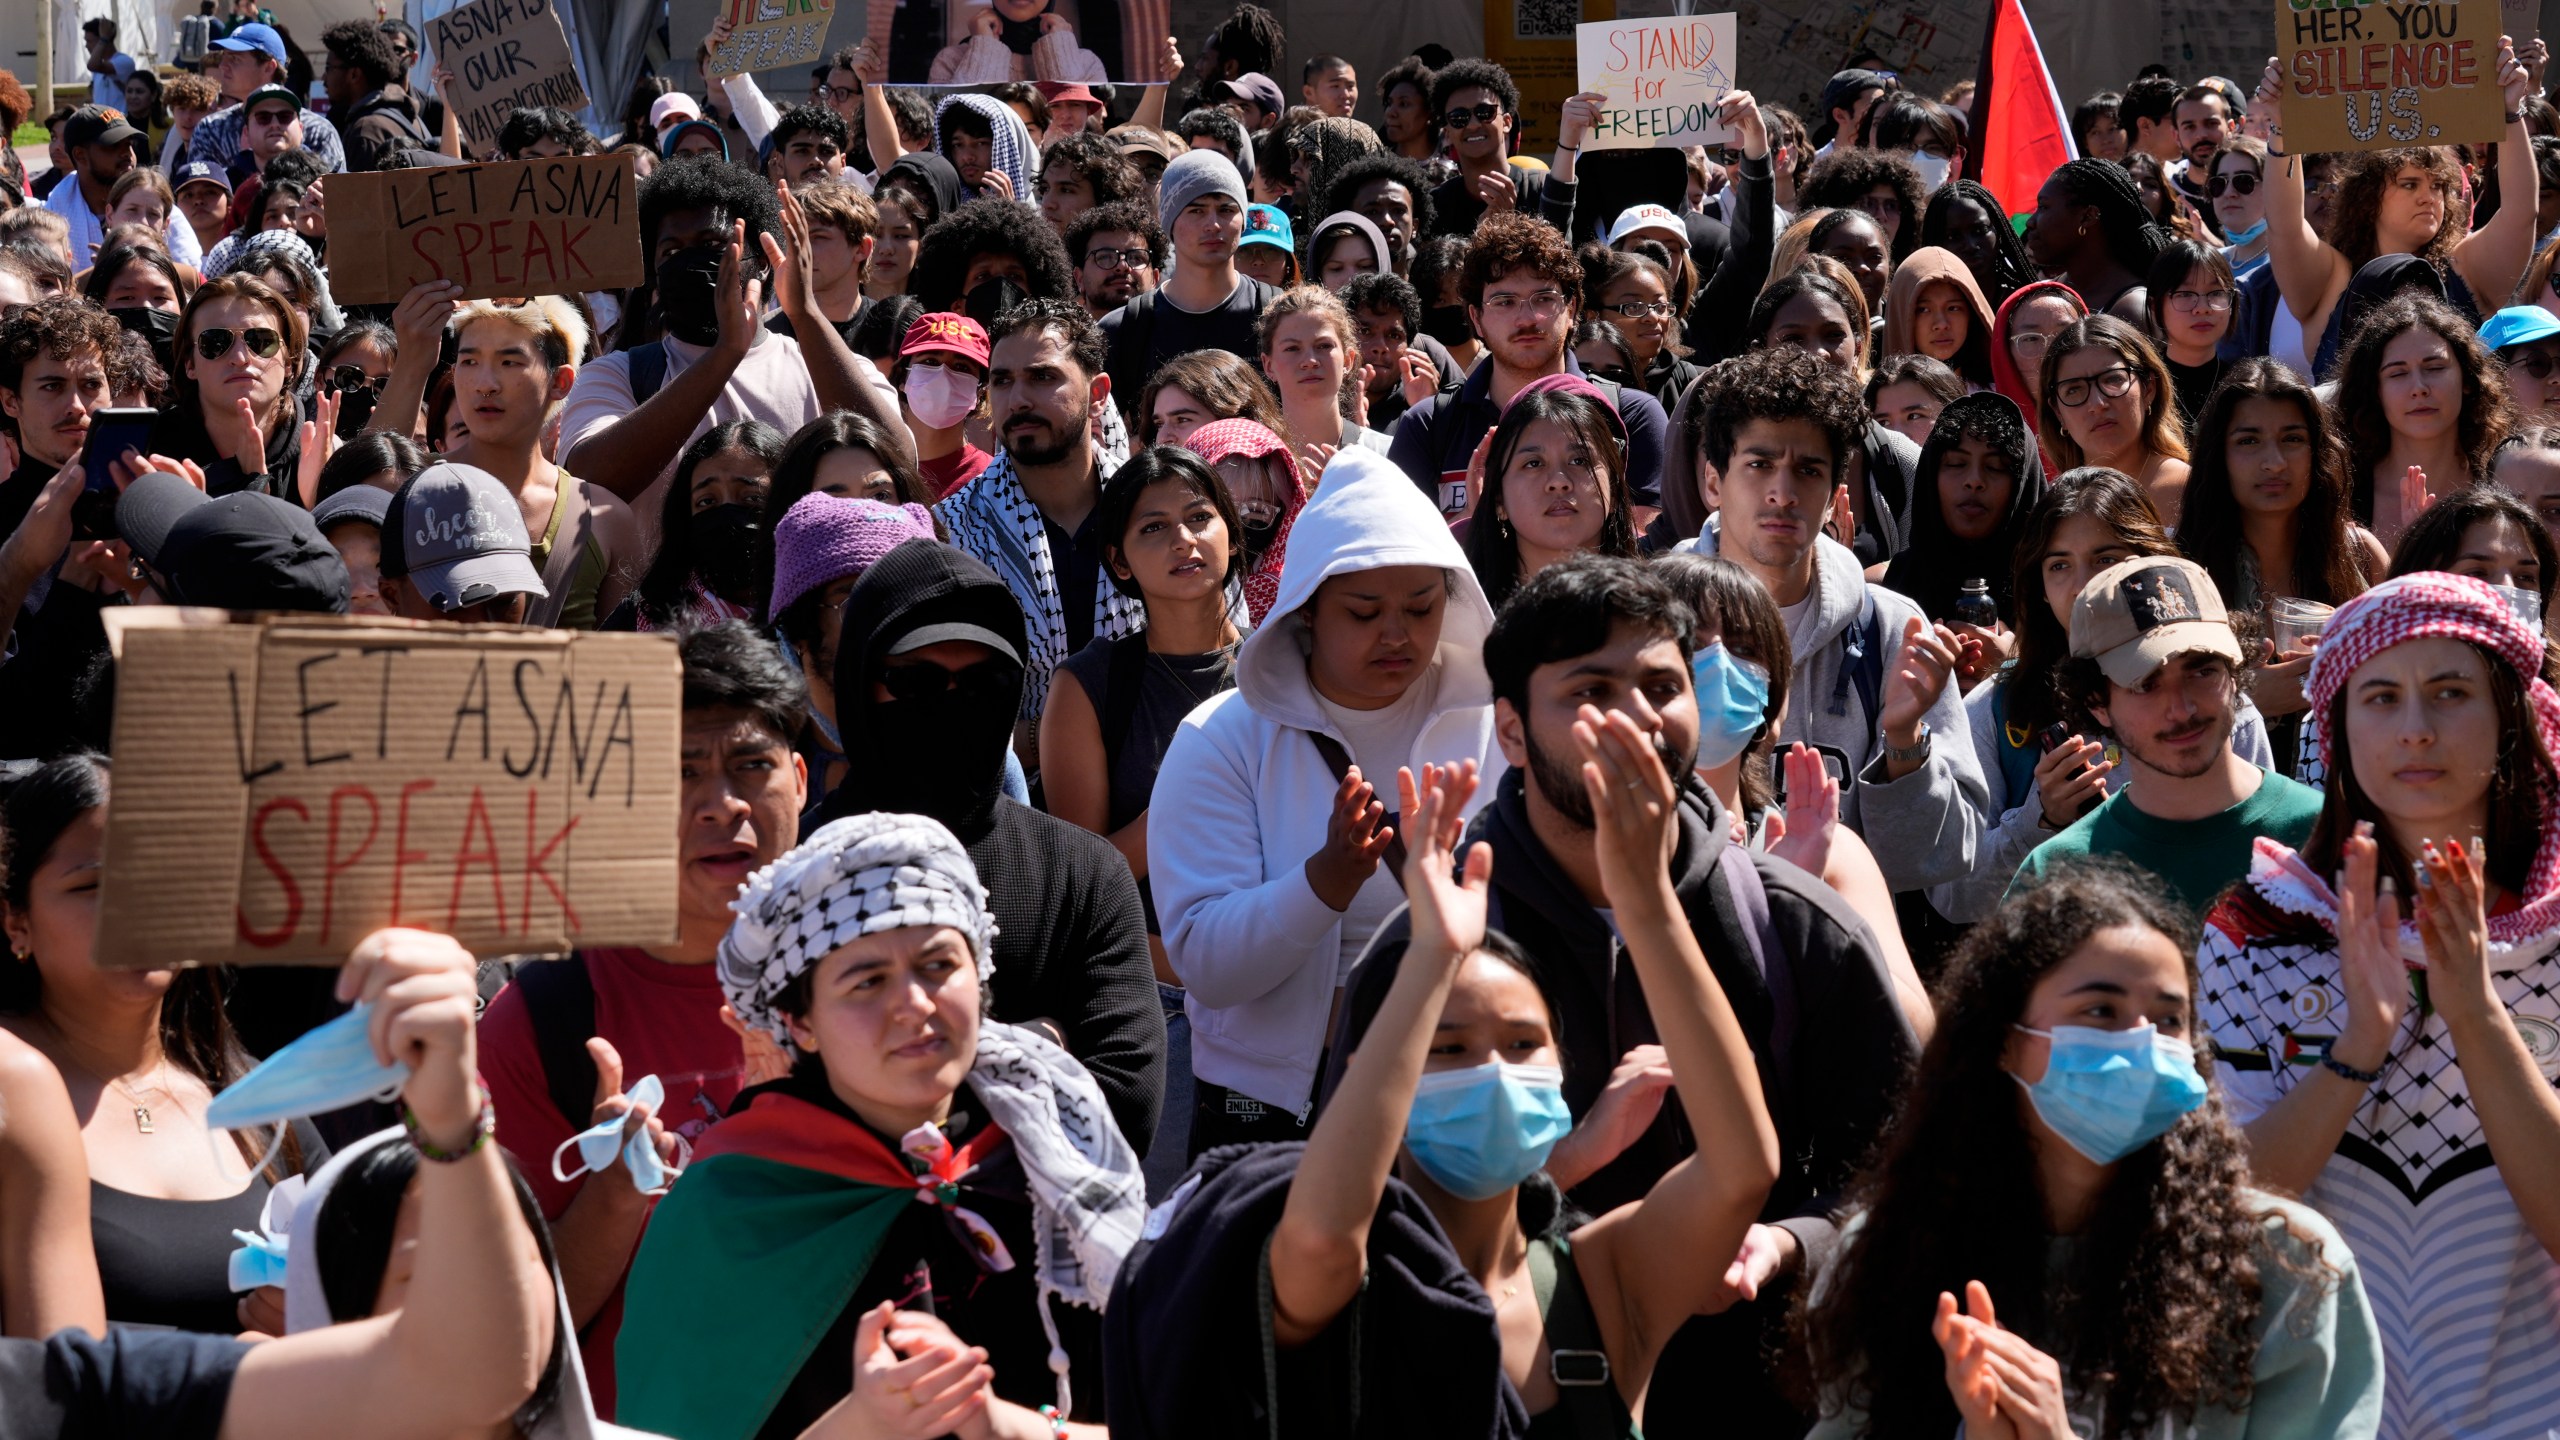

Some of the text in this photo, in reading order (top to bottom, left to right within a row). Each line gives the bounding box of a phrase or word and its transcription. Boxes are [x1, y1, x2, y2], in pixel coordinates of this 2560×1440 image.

[437, 0, 512, 60] ASNA
[711, 21, 823, 73] SPEAK
[1606, 22, 1714, 73] STAND
[2293, 7, 2375, 45] HER,
[2386, 4, 2457, 40] YOU
[464, 40, 537, 92] OUR
[1632, 76, 1666, 103] for
[2292, 39, 2480, 98] SILENCE
[1594, 102, 1726, 140] FREEDOM
[2345, 87, 2441, 142] US.
[391, 163, 622, 230] LET ASNA
[1641, 207, 1672, 221] USC
[408, 219, 594, 288] SPEAK
[930, 320, 973, 340] USC
[228, 646, 635, 808] LET ASNA
[237, 779, 583, 949] SPEAK
